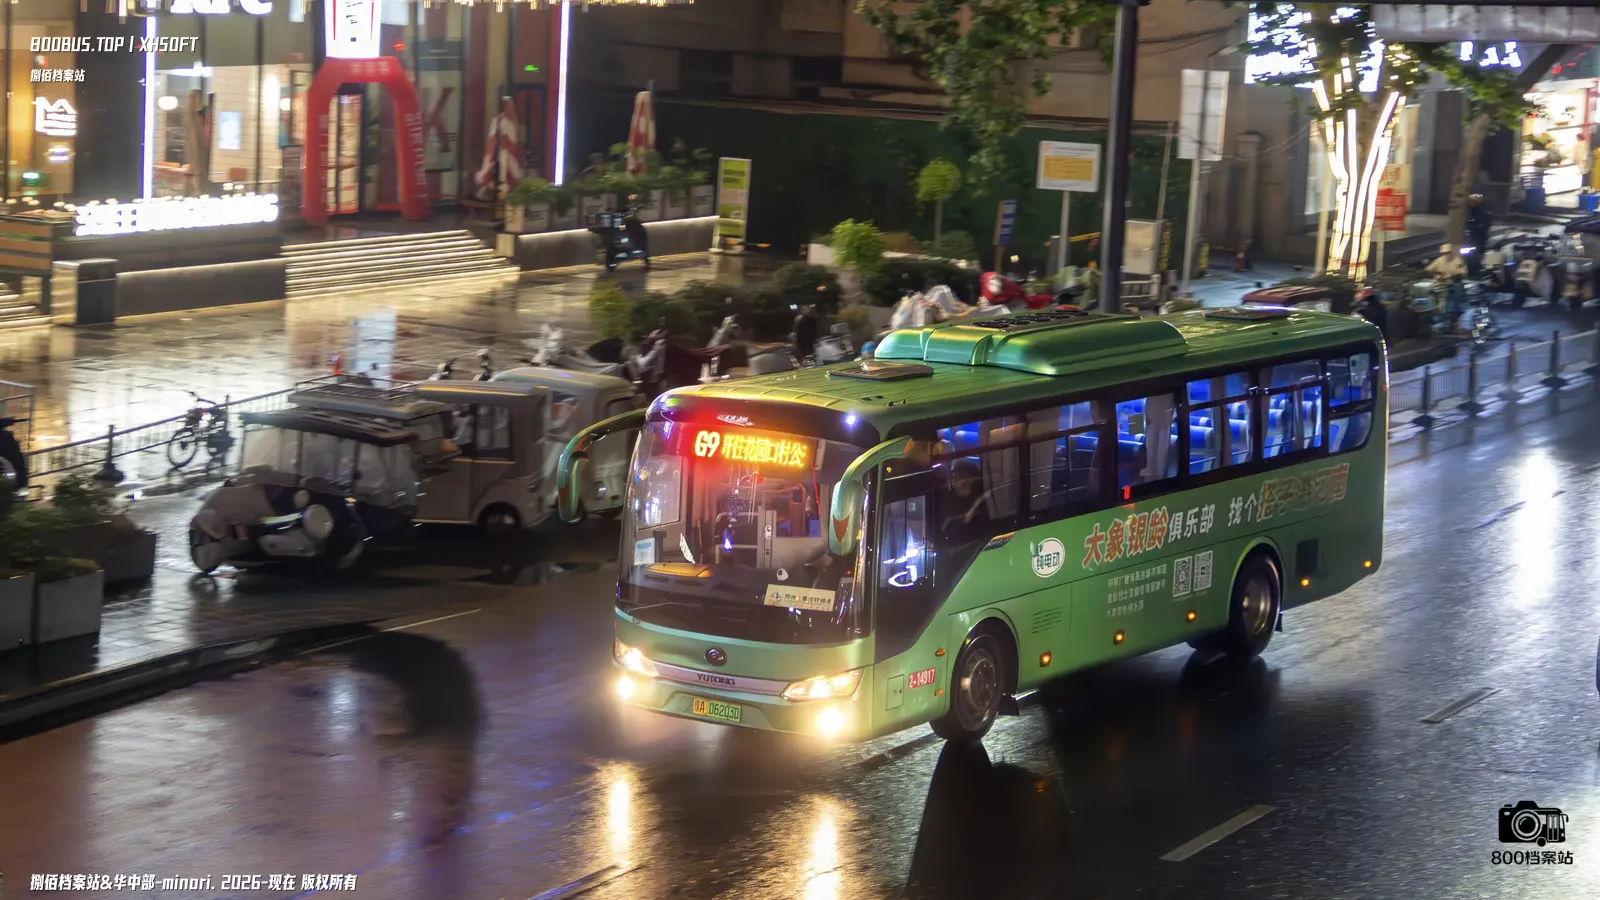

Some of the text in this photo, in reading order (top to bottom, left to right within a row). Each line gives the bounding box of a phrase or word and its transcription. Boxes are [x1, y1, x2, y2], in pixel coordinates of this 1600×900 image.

[694, 430, 721, 458] G9
[1081, 504, 1216, 570] 大象银龄俱乐部
[1036, 551, 1060, 570] 纯电动
[697, 673, 736, 686] YUTONG
[909, 667, 936, 689] 2-14917
